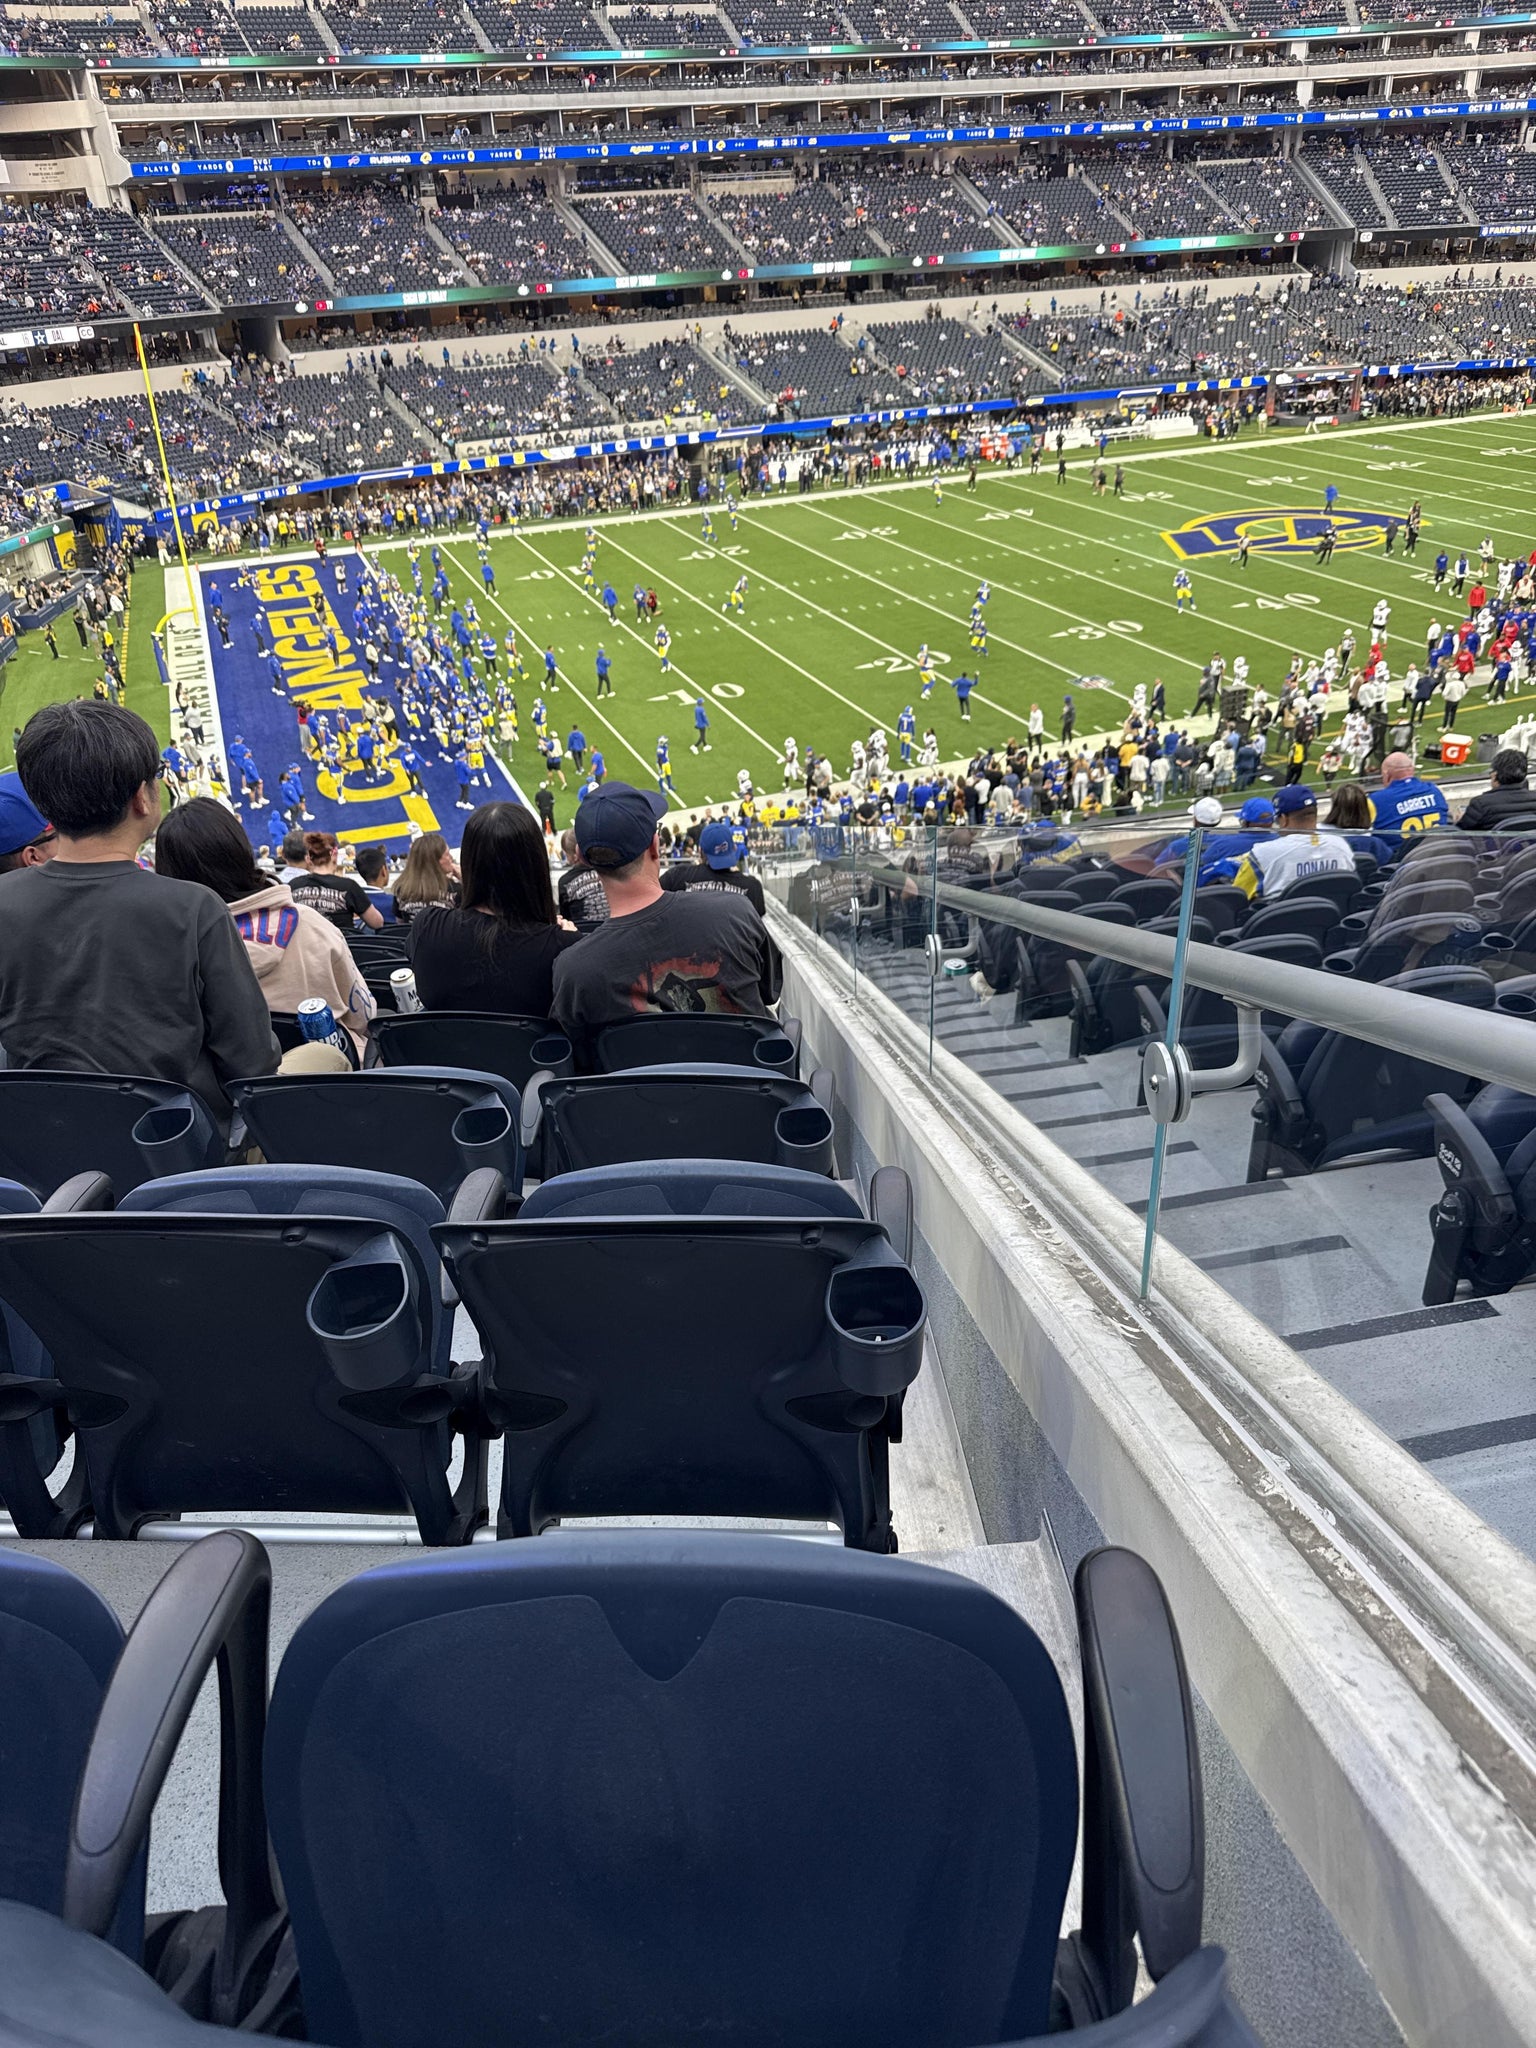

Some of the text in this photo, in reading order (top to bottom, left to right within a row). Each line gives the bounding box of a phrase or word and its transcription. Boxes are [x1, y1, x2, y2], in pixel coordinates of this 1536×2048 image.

[197, 164, 223, 173] YARDS
[370, 155, 411, 165] RUSHING
[143, 165, 169, 174] PLAYS
[1489, 226, 1528, 235] FANTASY
[590, 431, 700, 456] HOUSE
[431, 452, 526, 475] RAMS
[1256, 593, 1321, 610] 40
[256, 564, 370, 711] ANGELES
[1067, 620, 1144, 640] 30
[872, 651, 952, 674] 20
[666, 682, 746, 706] 10
[1445, 746, 1460, 759] G
[1395, 793, 1437, 816] GARRETT
[1296, 859, 1338, 877] DONALD
[318, 899, 336, 911] TOUR
